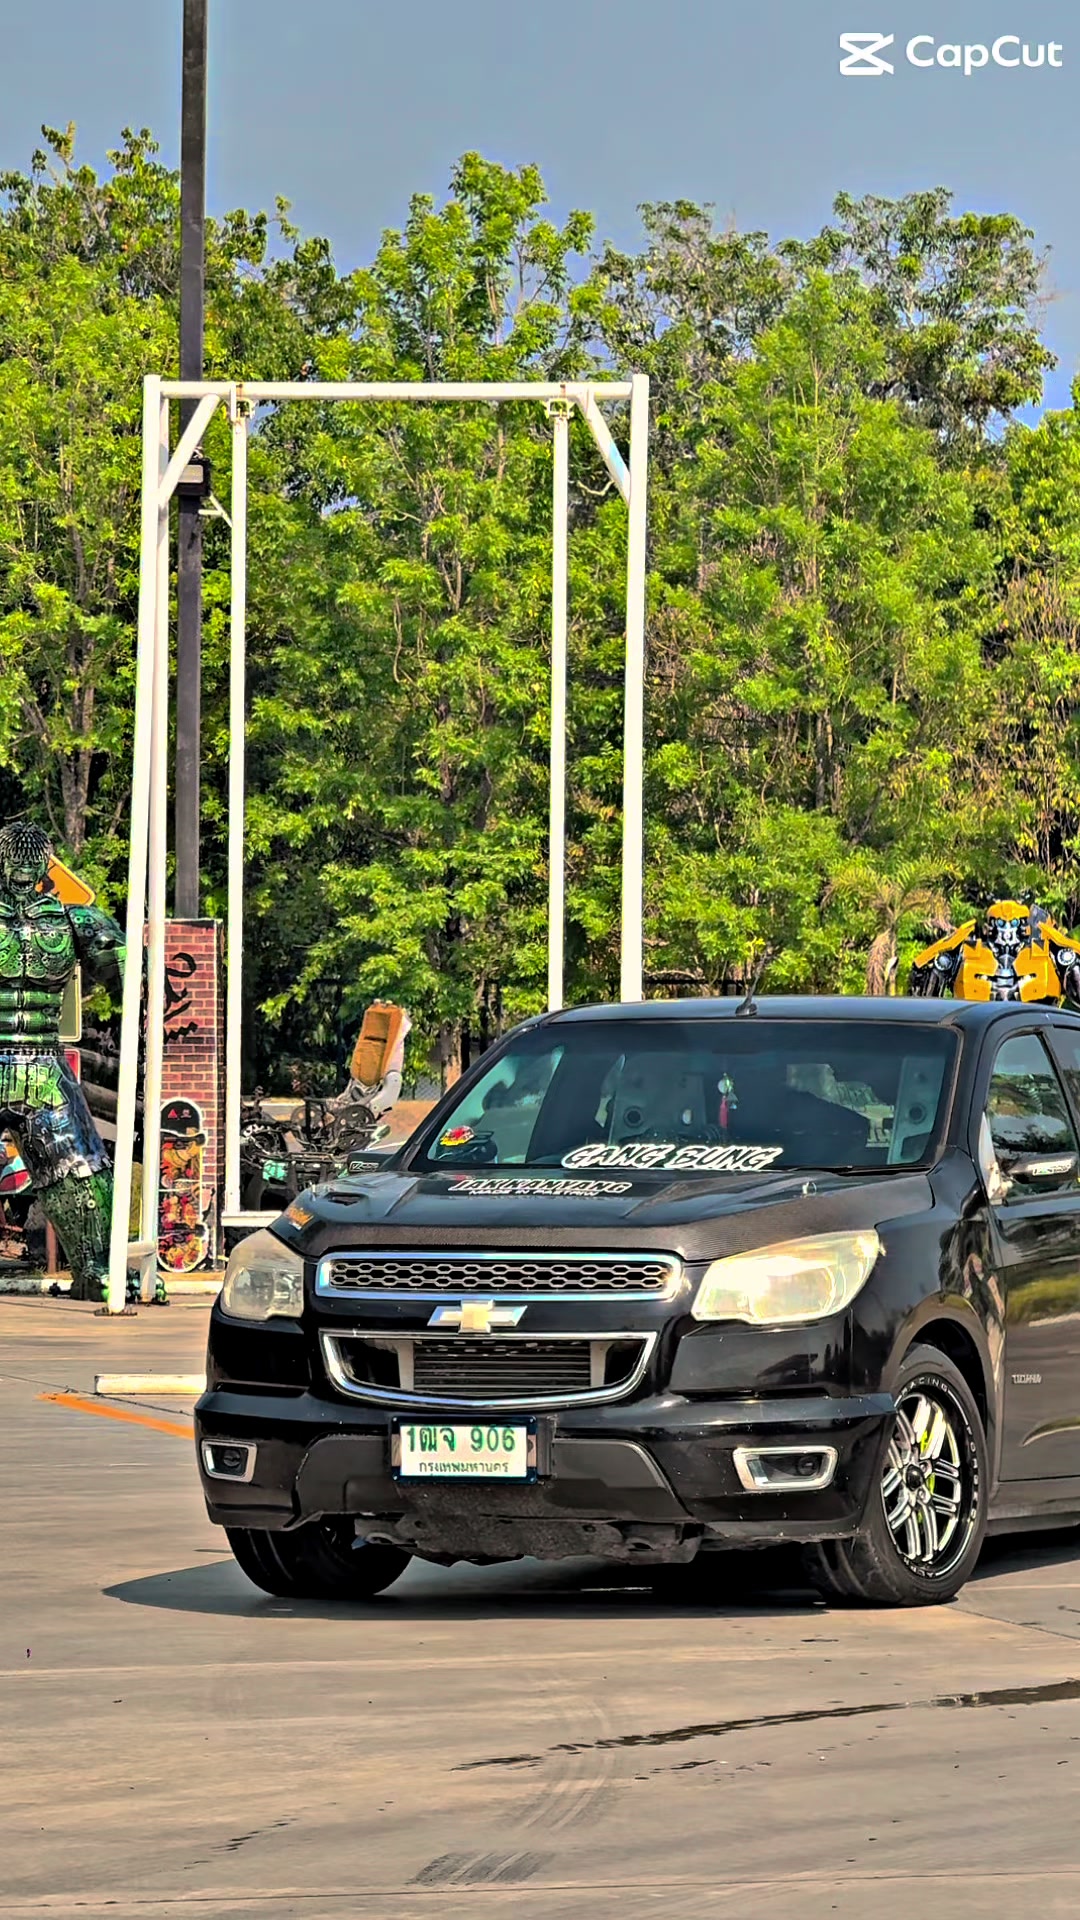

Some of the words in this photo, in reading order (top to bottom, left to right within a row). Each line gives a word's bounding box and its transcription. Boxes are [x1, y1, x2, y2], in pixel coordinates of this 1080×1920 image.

[561, 1143, 676, 1170] GANG
[664, 1145, 784, 1171] BUNG
[470, 1426, 516, 1452] 906
